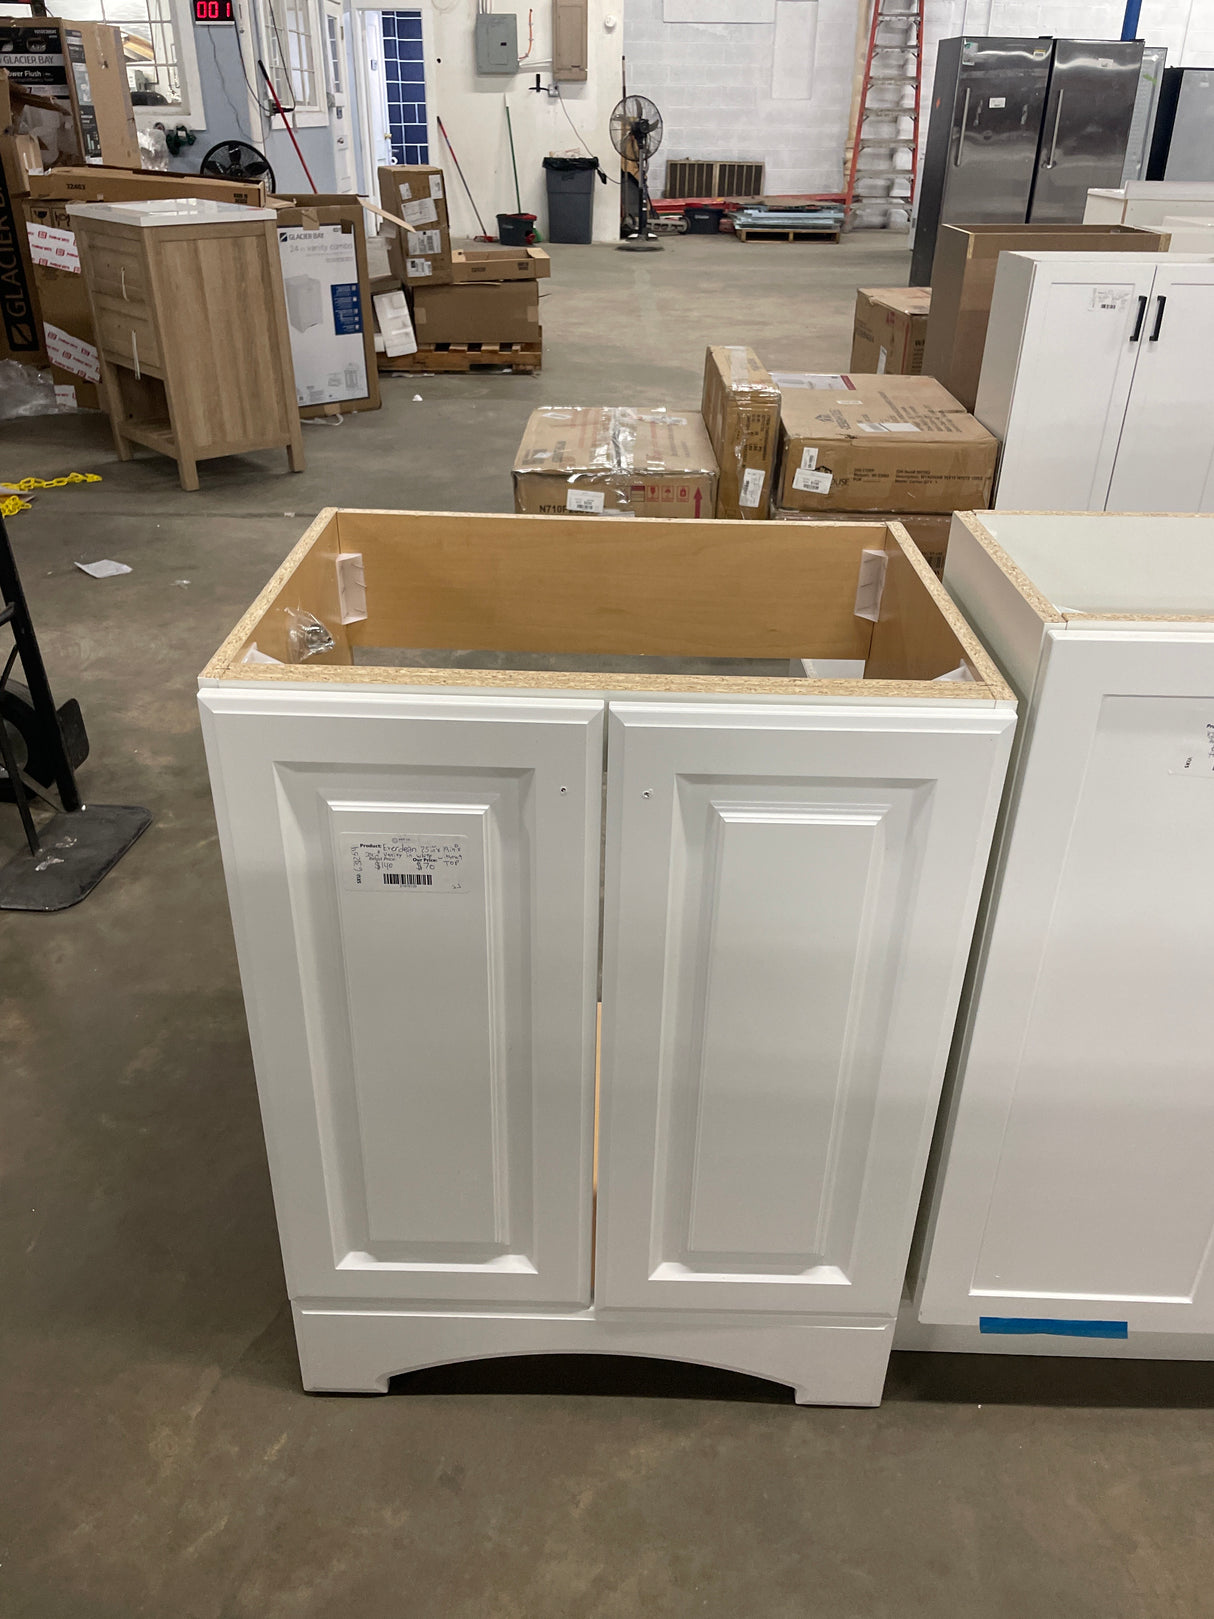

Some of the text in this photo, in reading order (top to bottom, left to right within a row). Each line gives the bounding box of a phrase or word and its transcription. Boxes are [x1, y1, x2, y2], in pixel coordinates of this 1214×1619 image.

[3, 56, 54, 65] GLACIER BAY
[416, 861, 436, 871] $70
